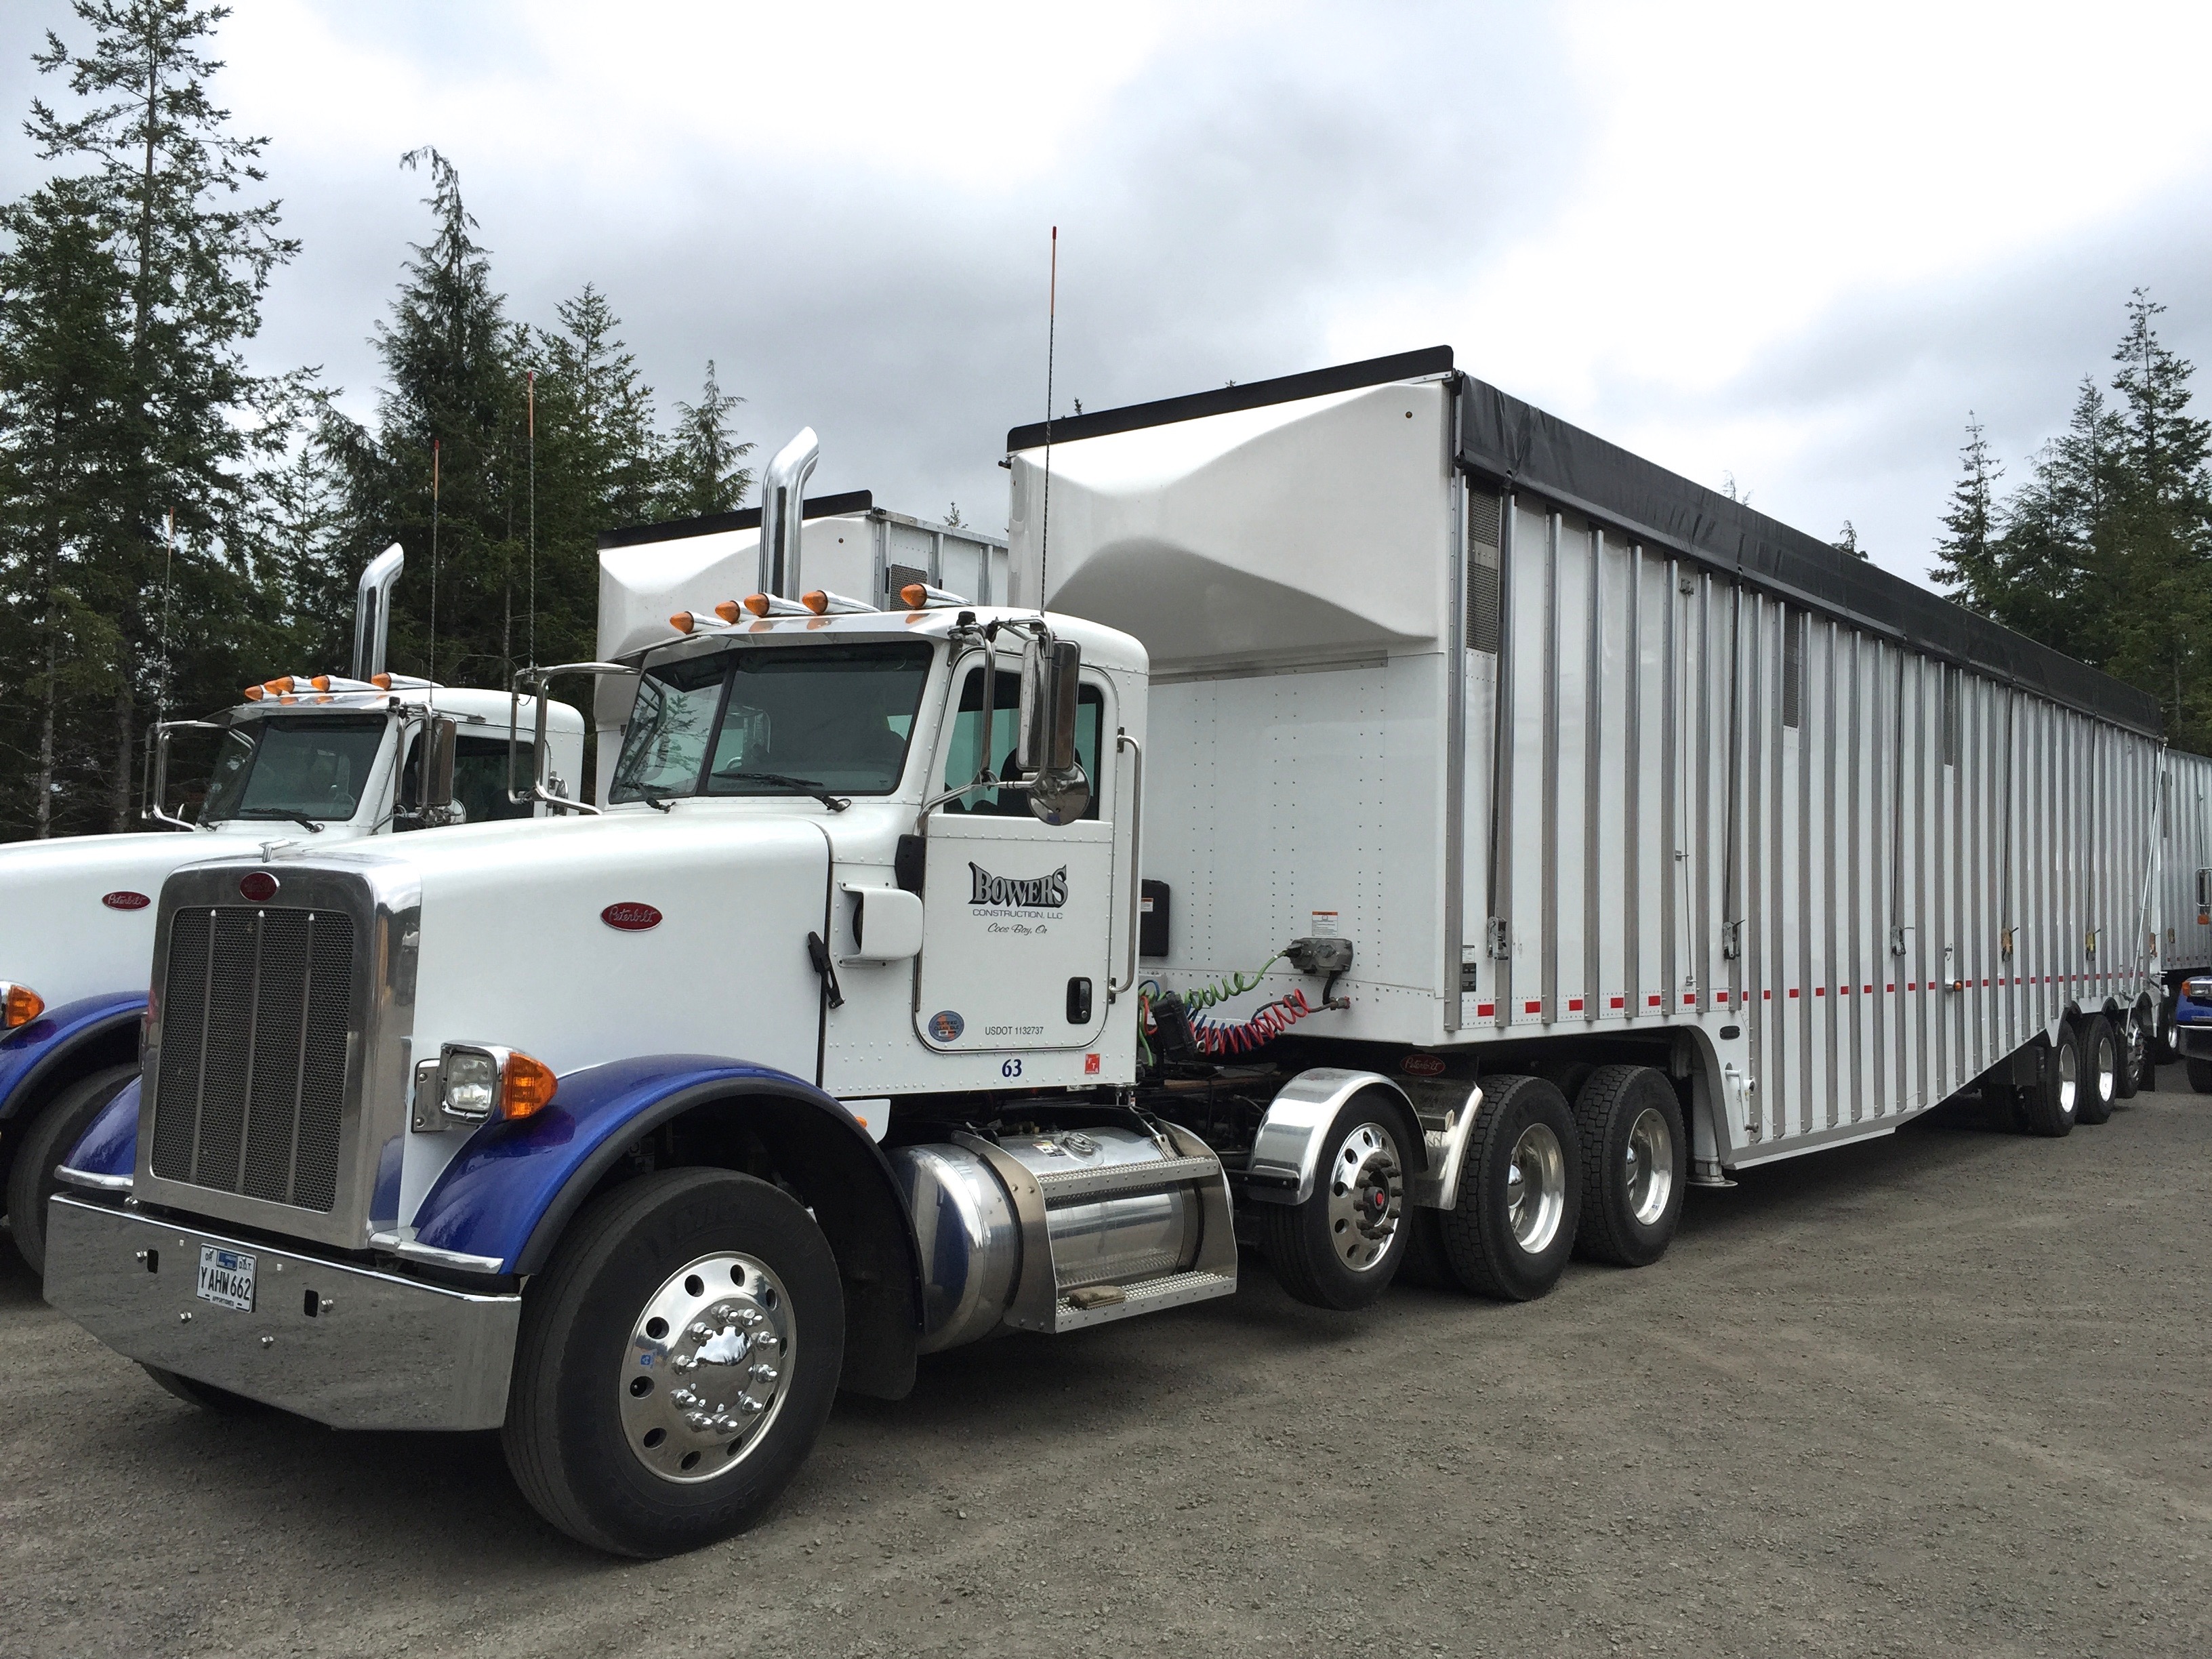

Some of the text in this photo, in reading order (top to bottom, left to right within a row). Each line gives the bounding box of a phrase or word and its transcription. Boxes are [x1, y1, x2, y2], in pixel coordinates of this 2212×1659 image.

[968, 861, 1068, 908] BOWERS
[609, 905, 658, 922] Peterbilt
[1047, 912, 1063, 920] LLC
[987, 922, 1010, 933] Coos
[1035, 924, 1048, 934] Or
[985, 1026, 1044, 1036] USDOT 1132737
[1002, 1059, 1022, 1078] 63
